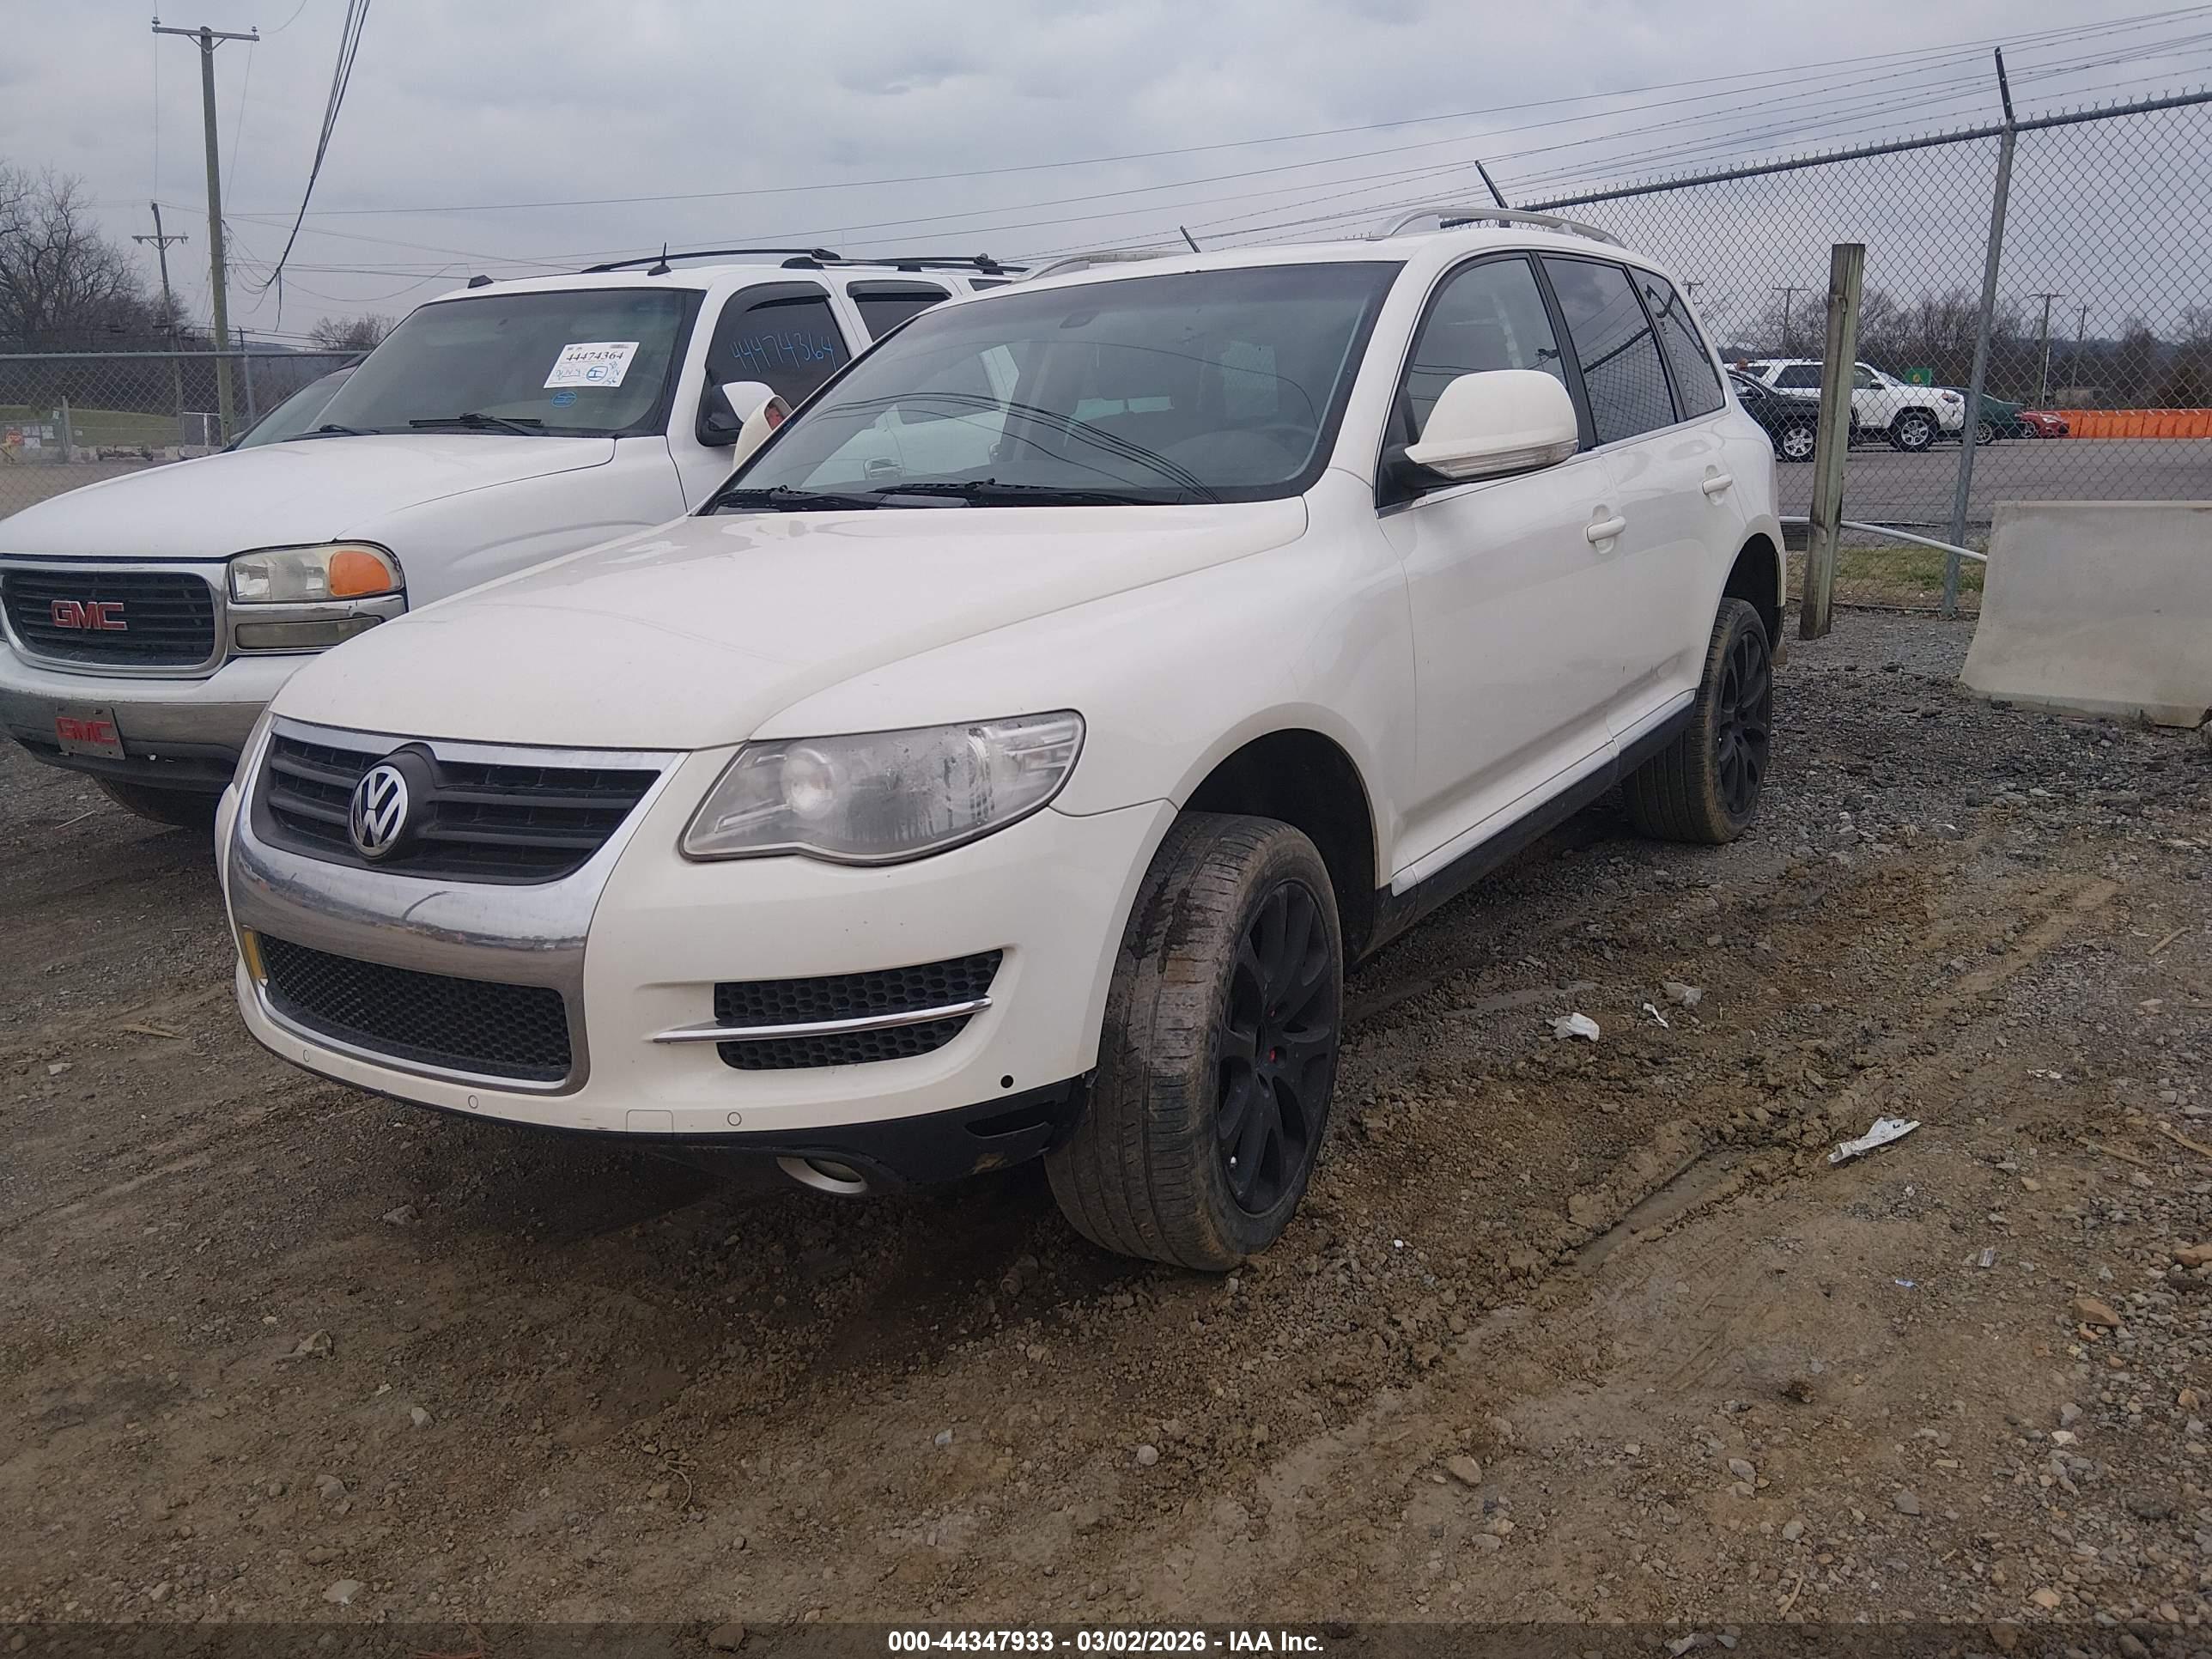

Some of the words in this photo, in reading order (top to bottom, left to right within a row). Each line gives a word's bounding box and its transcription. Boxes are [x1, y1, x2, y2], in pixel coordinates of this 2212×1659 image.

[566, 351, 624, 361] 44474364
[730, 330, 837, 373] 44474364
[52, 599, 128, 630] GMC
[55, 716, 117, 745] GMC
